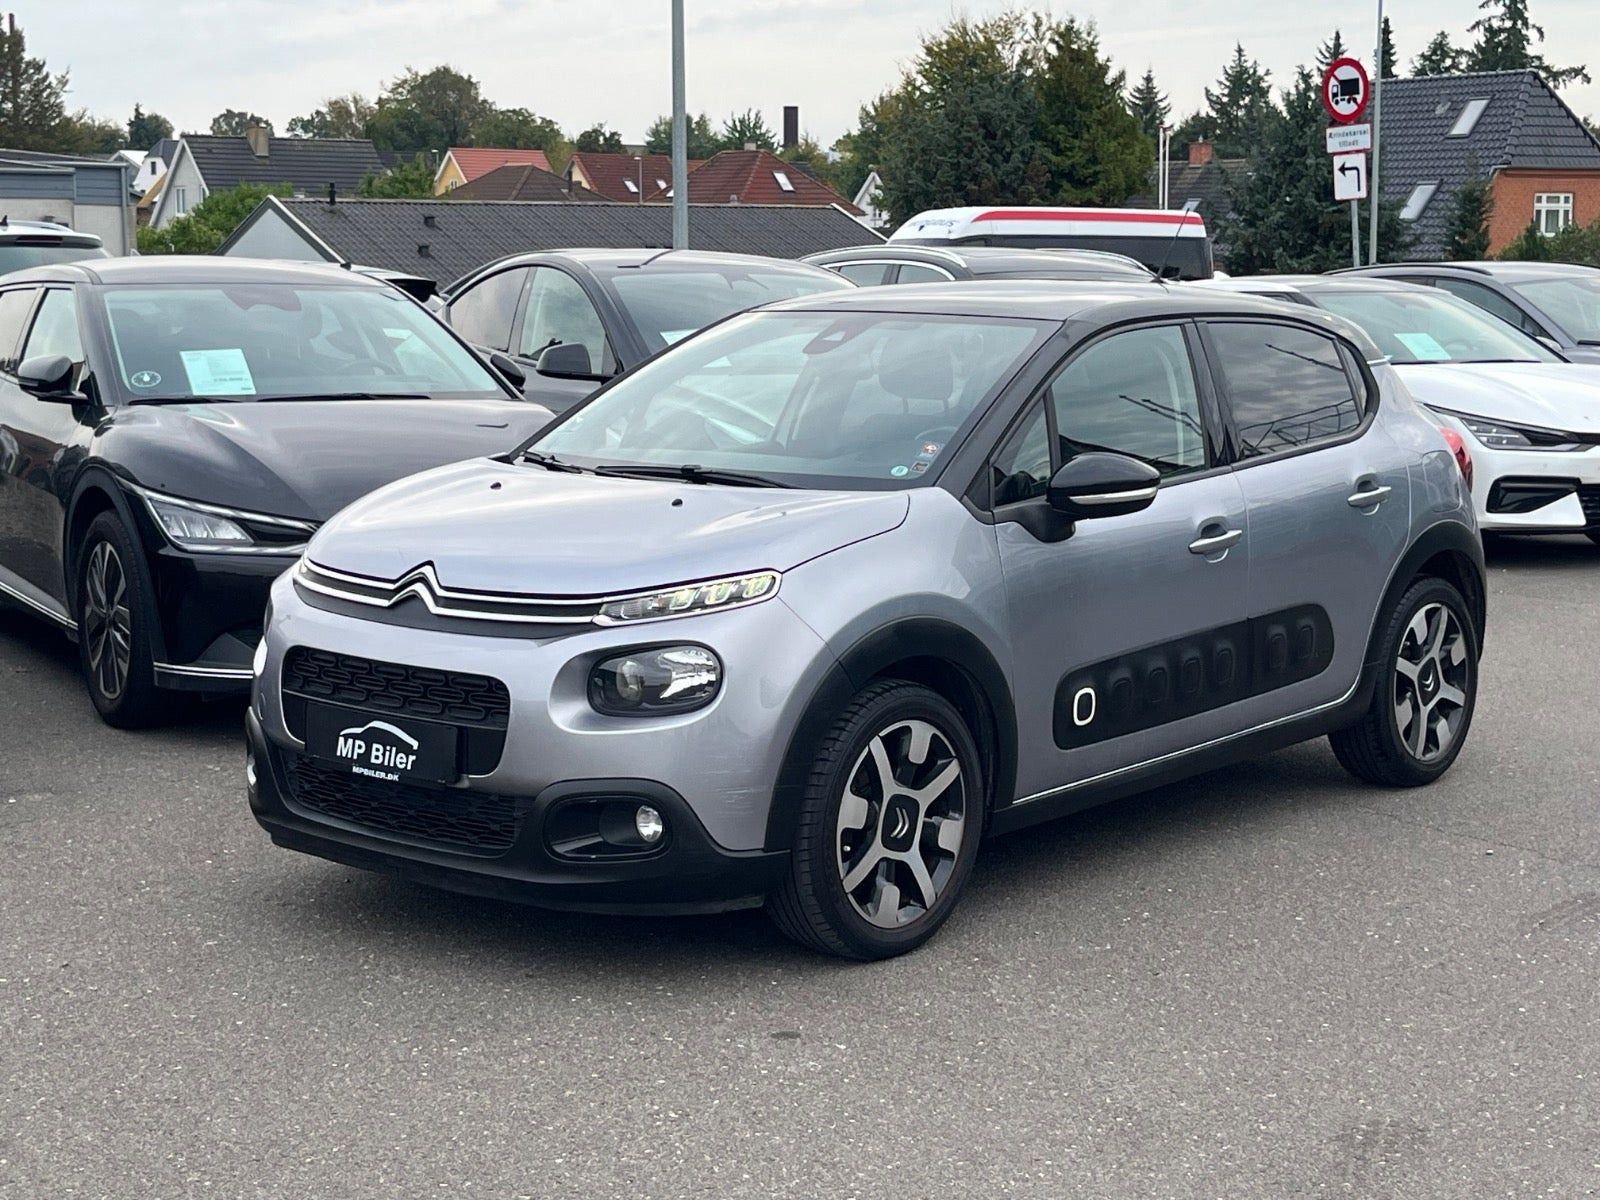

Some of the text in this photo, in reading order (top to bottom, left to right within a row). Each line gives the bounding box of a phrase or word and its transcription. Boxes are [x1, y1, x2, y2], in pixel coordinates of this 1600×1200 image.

[336, 736, 417, 770] MP Biler
[352, 765, 399, 782] MPBILER.DK
